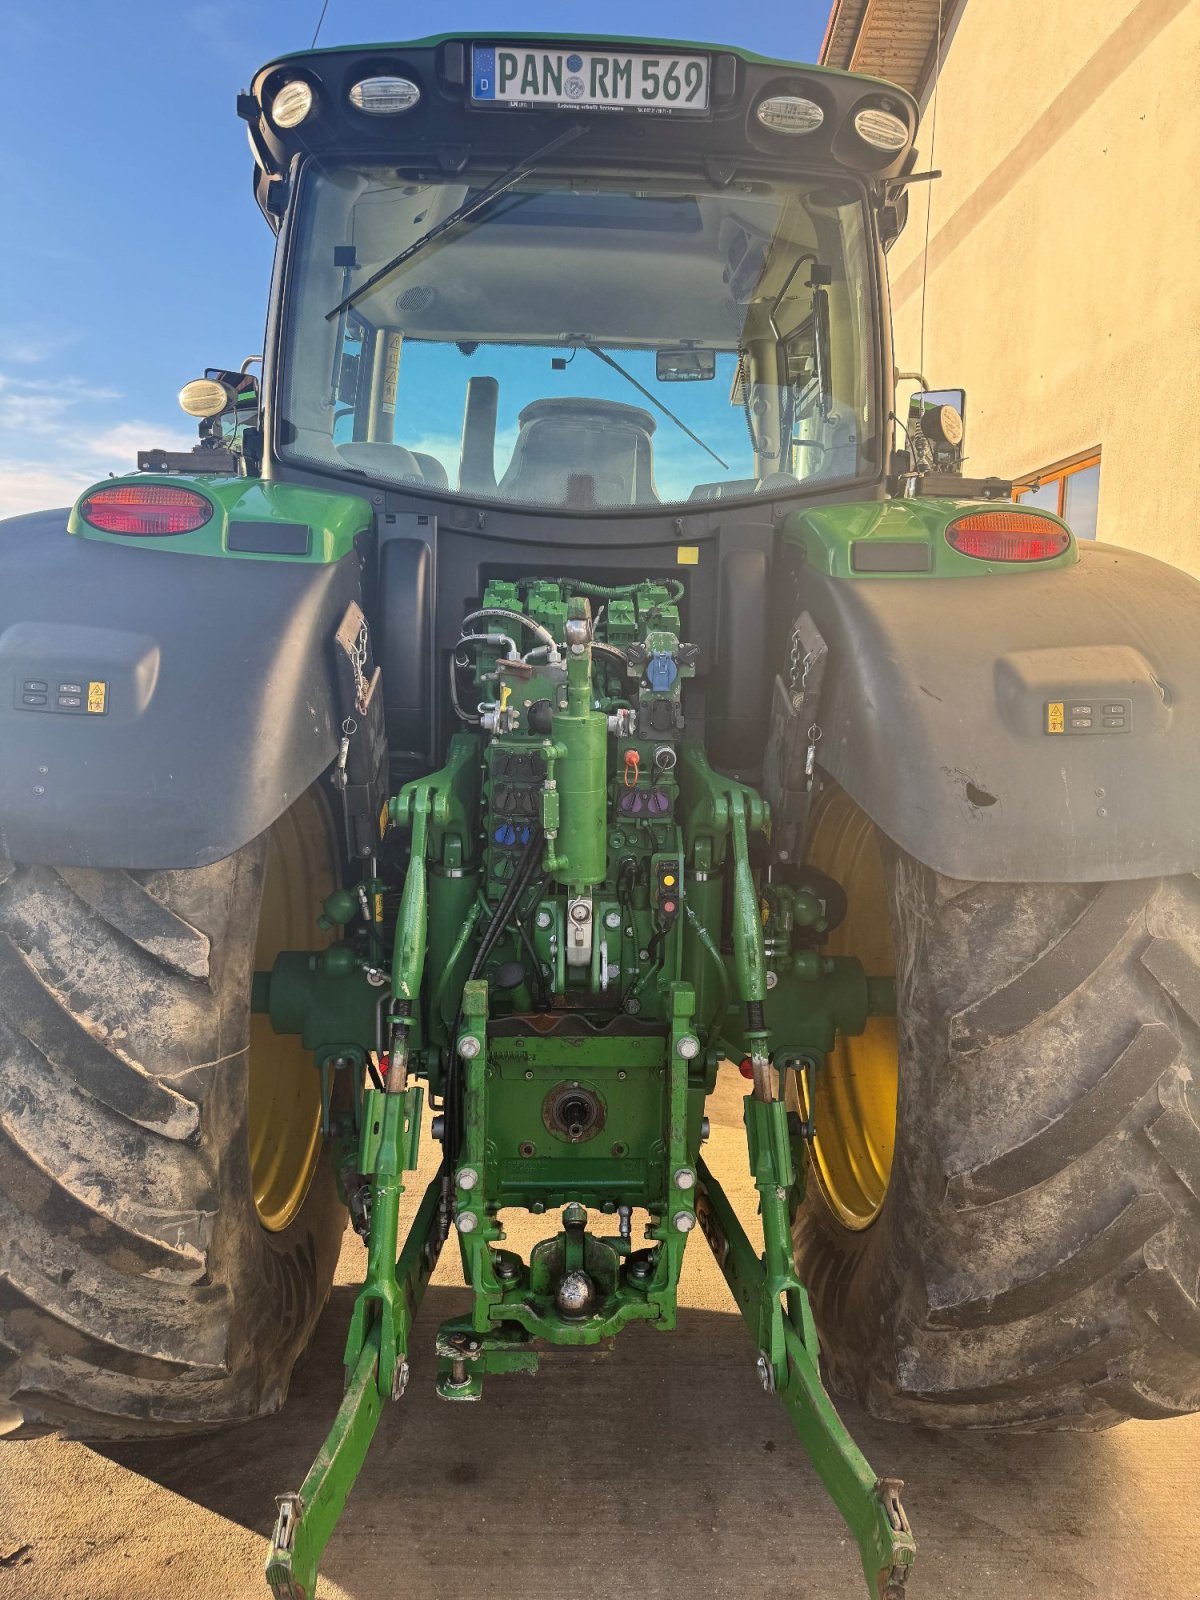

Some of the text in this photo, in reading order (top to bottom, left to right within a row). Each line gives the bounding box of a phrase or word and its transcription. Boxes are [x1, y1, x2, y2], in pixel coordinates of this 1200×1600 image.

[481, 79, 489, 91] D
[498, 53, 703, 102] PAN RM 569
